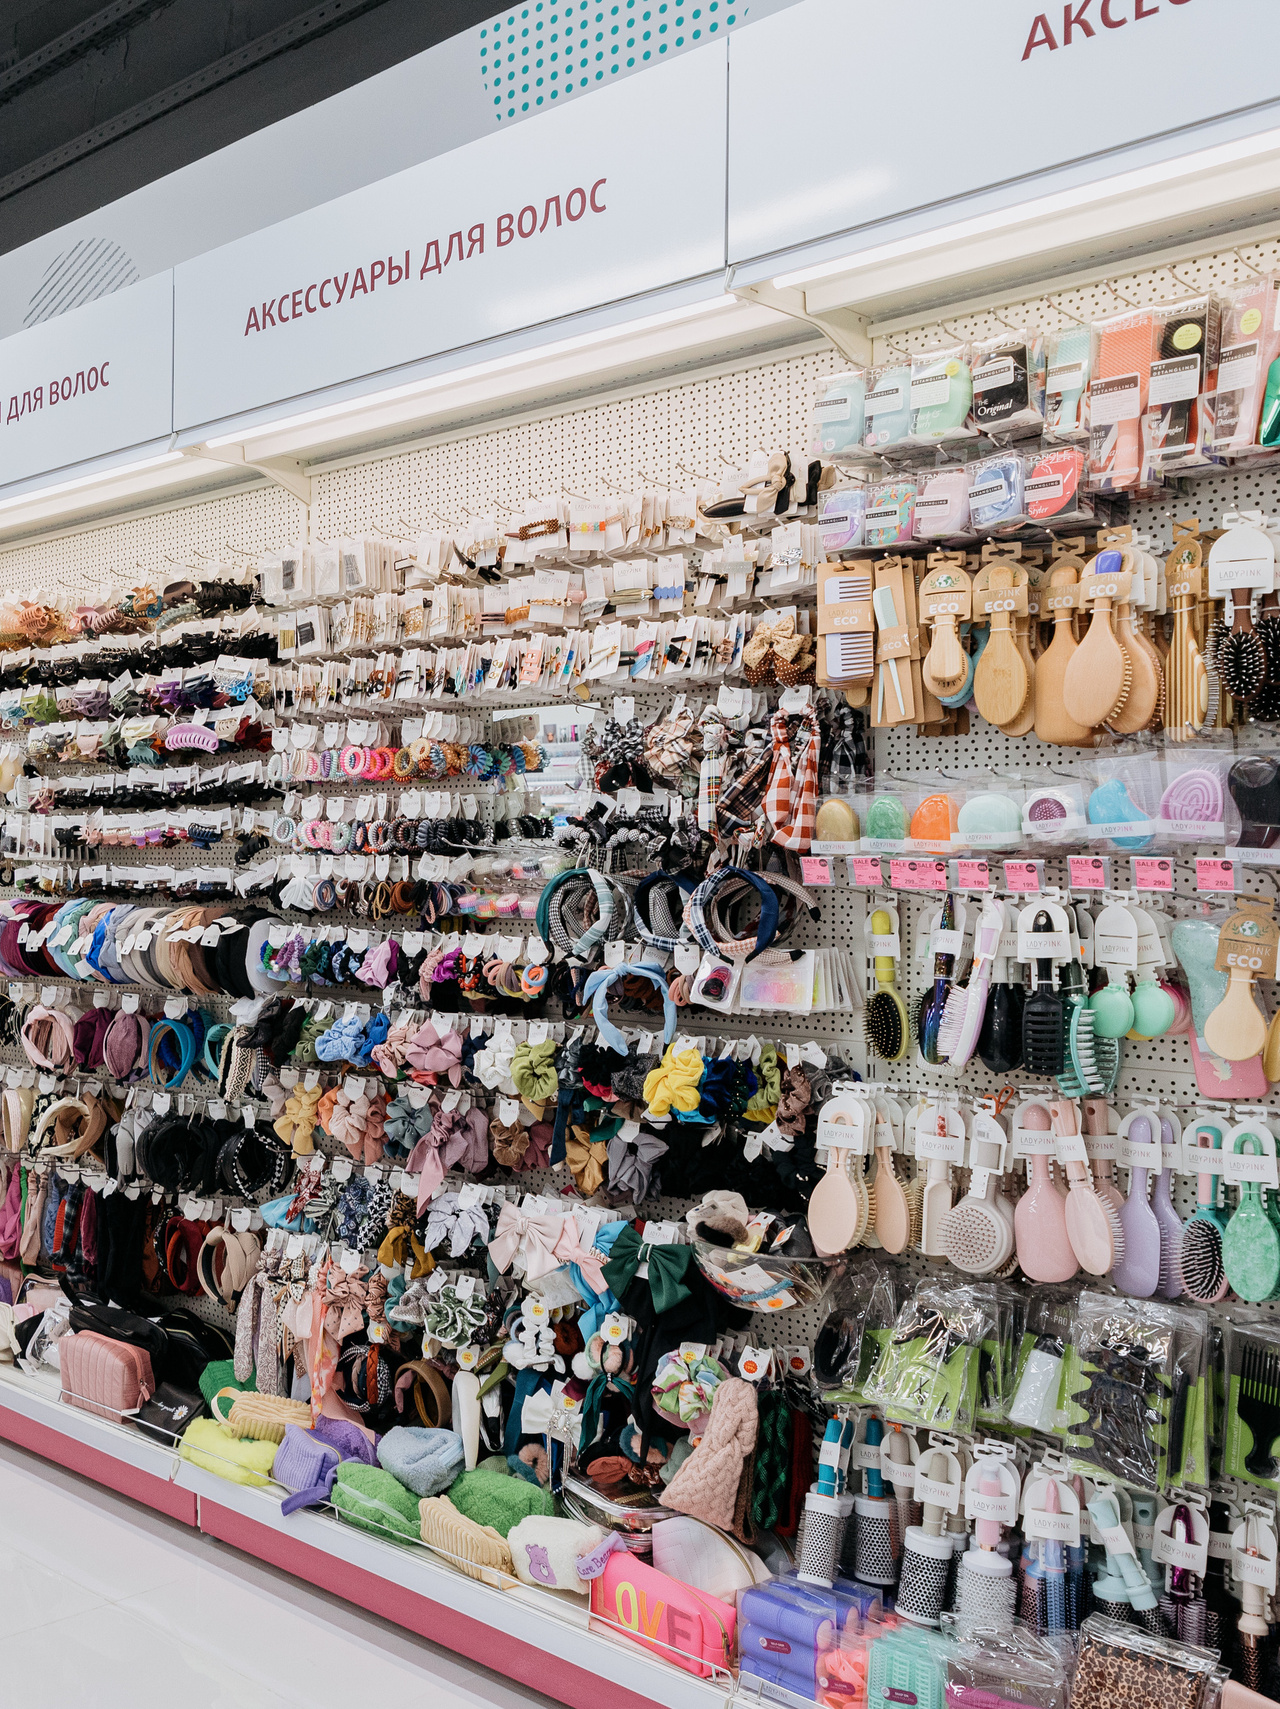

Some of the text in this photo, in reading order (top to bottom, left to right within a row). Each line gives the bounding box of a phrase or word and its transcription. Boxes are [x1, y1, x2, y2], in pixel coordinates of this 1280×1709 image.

[1020, 0, 1194, 61] АКС
[244, 178, 607, 336] АКСЕССУАРЫ ДЛЯ ВОЛОС
[1222, 350, 1255, 363] DETANGLING
[974, 368, 1009, 380] DETANGLING
[1152, 364, 1195, 376] DETANGLING
[912, 374, 947, 385] DETANGLING
[6, 386, 43, 425] ДЛЯ
[49, 362, 110, 406] ВОЛОС
[1093, 383, 1135, 396] DETANGLING
[978, 398, 989, 406] THE
[977, 399, 1013, 417] Original
[1028, 450, 1071, 462] TANGLE
[970, 484, 1002, 498] DETANGLING
[1025, 480, 1060, 491] DETANGLING
[574, 503, 601, 511] LADYPINK
[916, 499, 948, 507] DETANGLING
[866, 510, 896, 520] DETANGLING
[1028, 506, 1049, 517] Styler
[819, 517, 848, 526] DETANGLING
[617, 568, 641, 576] LADYPINK
[1220, 568, 1262, 579] LADYPINK
[1089, 582, 1118, 597] ECO
[1170, 582, 1190, 597] ECO
[984, 599, 1016, 613] ECO
[1048, 596, 1074, 608] ECO
[929, 602, 959, 615] ECO
[833, 616, 859, 626] ECO
[883, 641, 902, 651] ECO
[1101, 826, 1134, 835] LADYPINK
[1171, 823, 1206, 832] LADYPINK
[965, 834, 992, 842] LADYPINK
[1237, 850, 1274, 860] LADYPINK
[1026, 940, 1062, 949] LADYPINK
[1101, 944, 1130, 953] LADYPINK
[1220, 941, 1271, 957] LADYPINK
[1226, 953, 1262, 970] ECO
[823, 1130, 854, 1140] LADYPINK
[922, 1141, 955, 1151] LADYPINK
[1121, 1147, 1151, 1158] LADYPINK
[1229, 1162, 1265, 1172] LADYPINK
[921, 1484, 951, 1498] LADYPINK
[973, 1500, 1008, 1512] LADYPINK
[1033, 1518, 1071, 1530] LADYPINK
[1160, 1541, 1197, 1561] LADYPINK
[593, 1575, 693, 1656] LOVE
[1004, 1688, 1022, 1699] PRO
